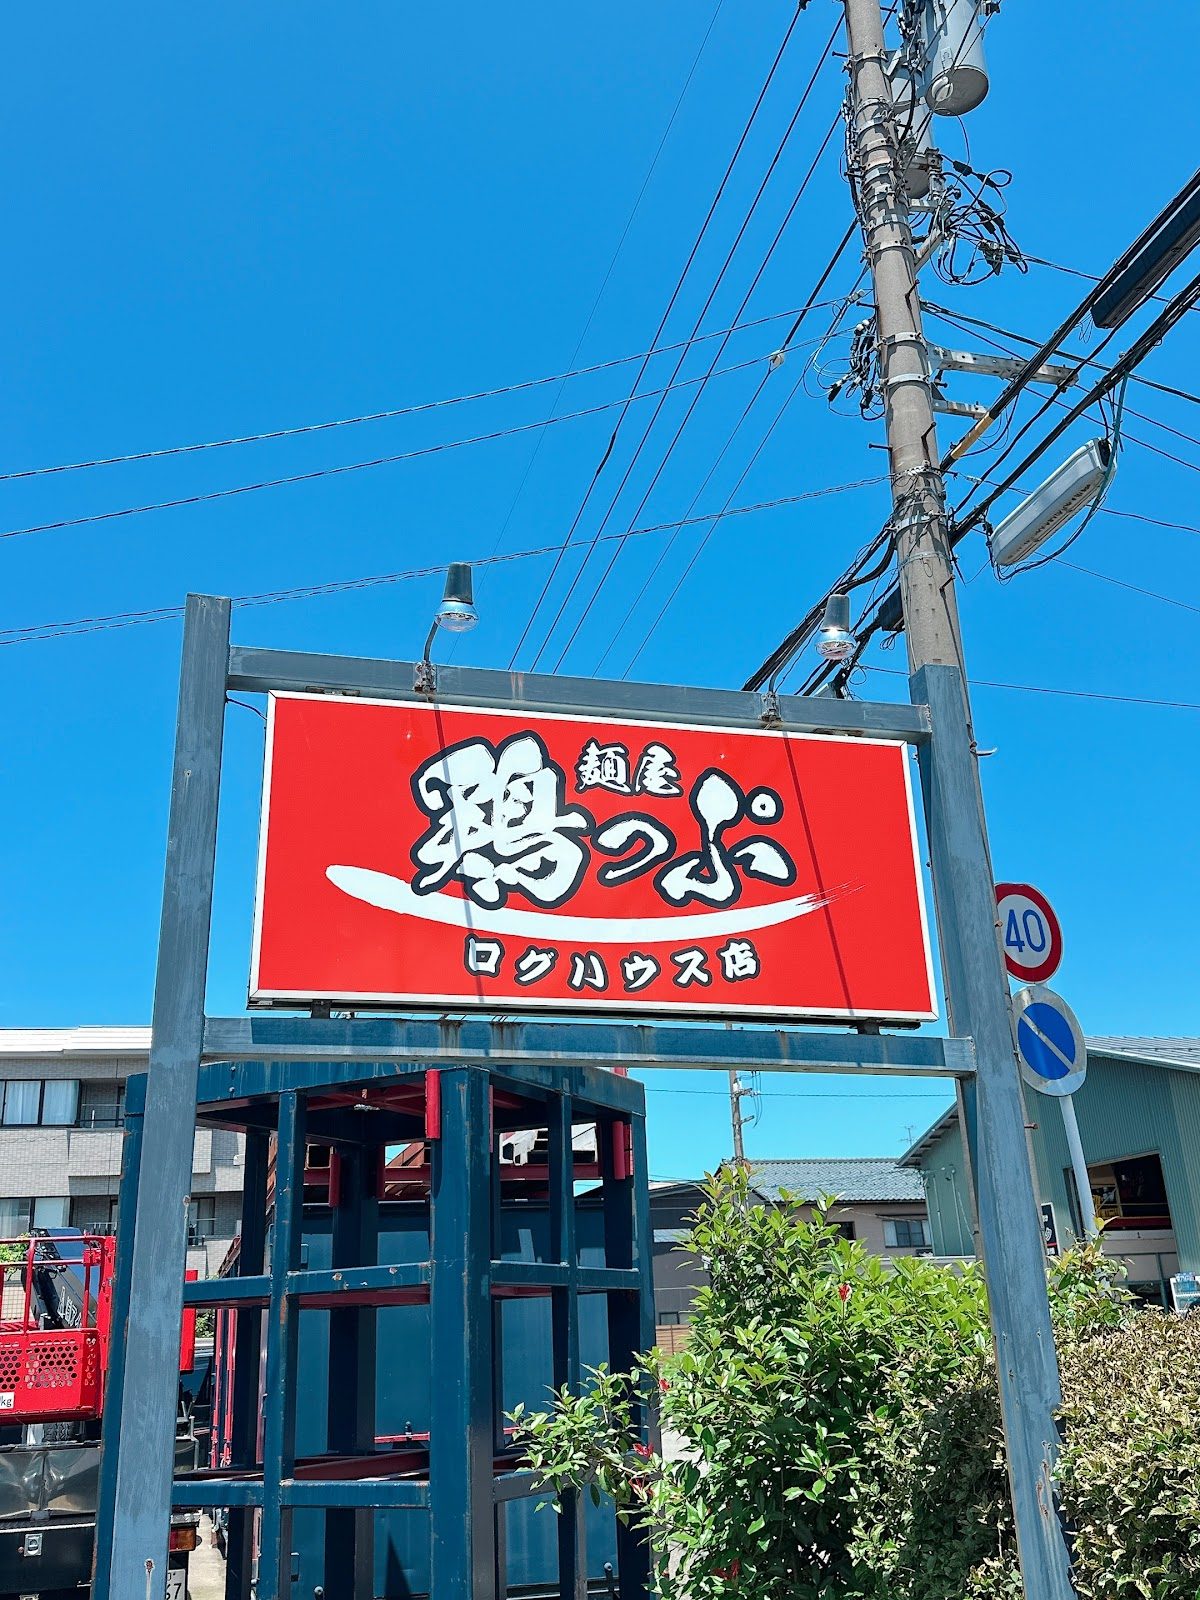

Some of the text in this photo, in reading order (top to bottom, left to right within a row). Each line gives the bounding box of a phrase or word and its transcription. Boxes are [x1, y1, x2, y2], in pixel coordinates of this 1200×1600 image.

[577, 739, 682, 796] 麺屋
[1005, 909, 1046, 953] 40
[465, 935, 760, 990] ログハウス店
